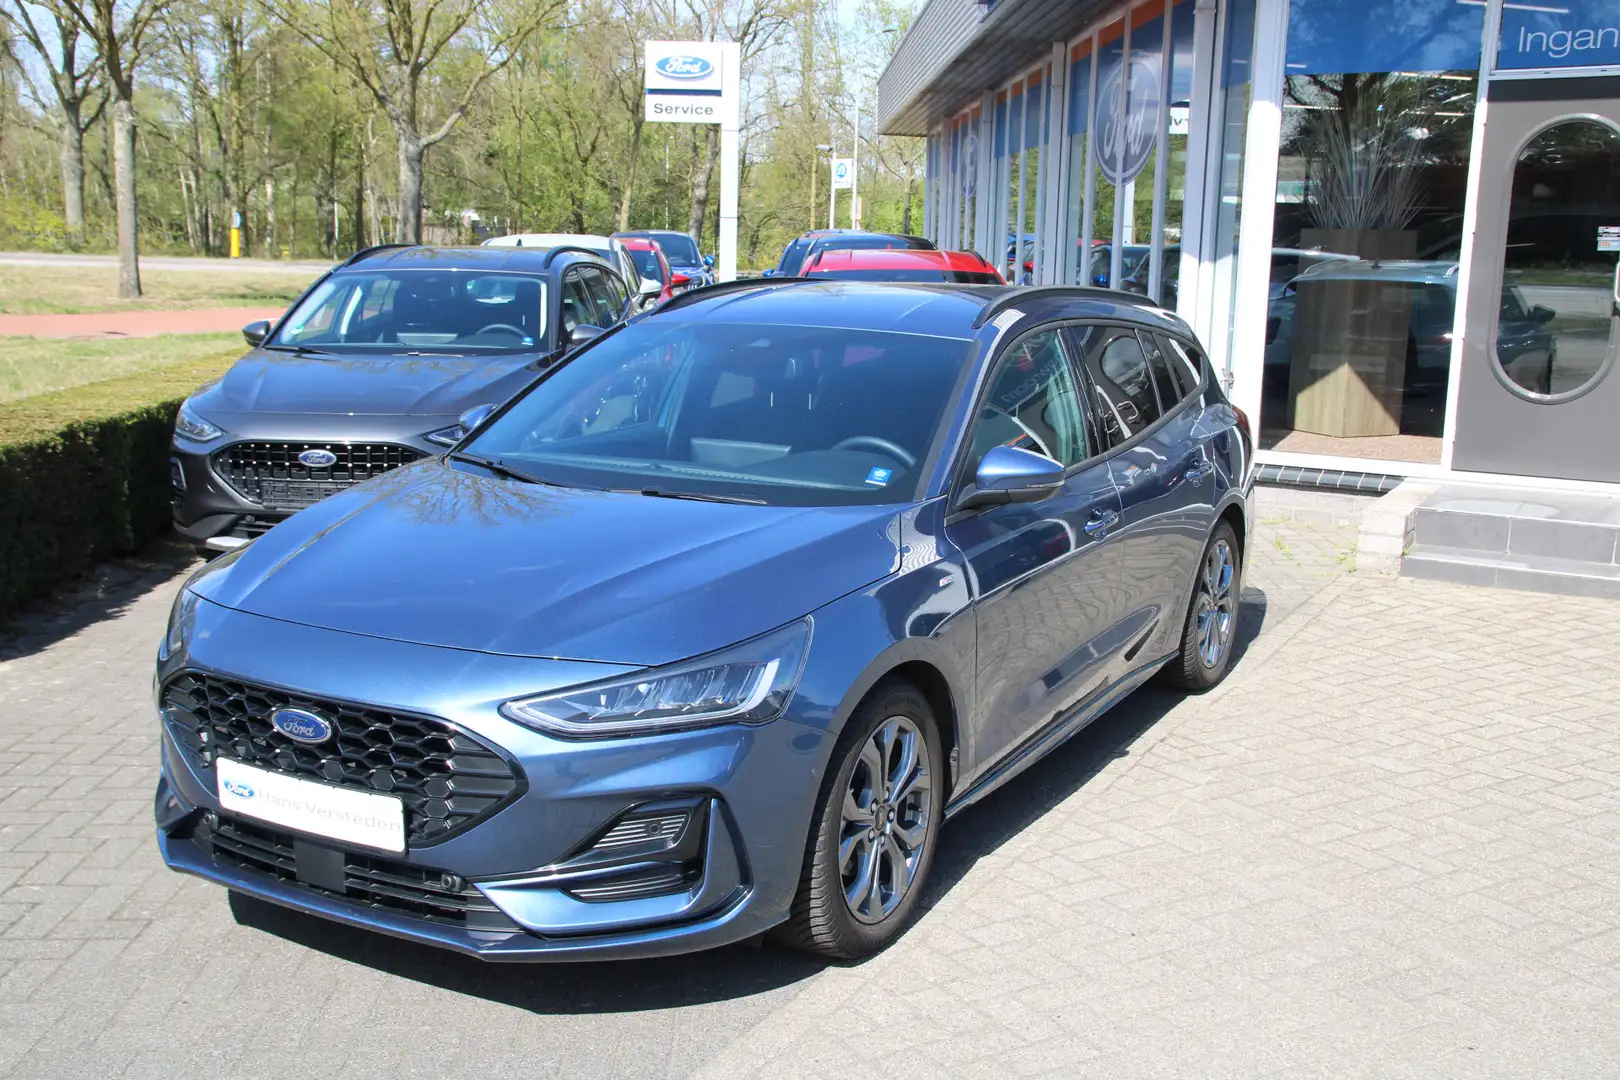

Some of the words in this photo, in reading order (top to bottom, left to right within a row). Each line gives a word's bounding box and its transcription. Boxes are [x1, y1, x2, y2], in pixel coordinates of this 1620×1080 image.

[653, 102, 714, 115] Service
[282, 714, 317, 737] Ford
[226, 779, 253, 798] Ford
[258, 787, 301, 811] Hans
[305, 799, 401, 834] Versteden
